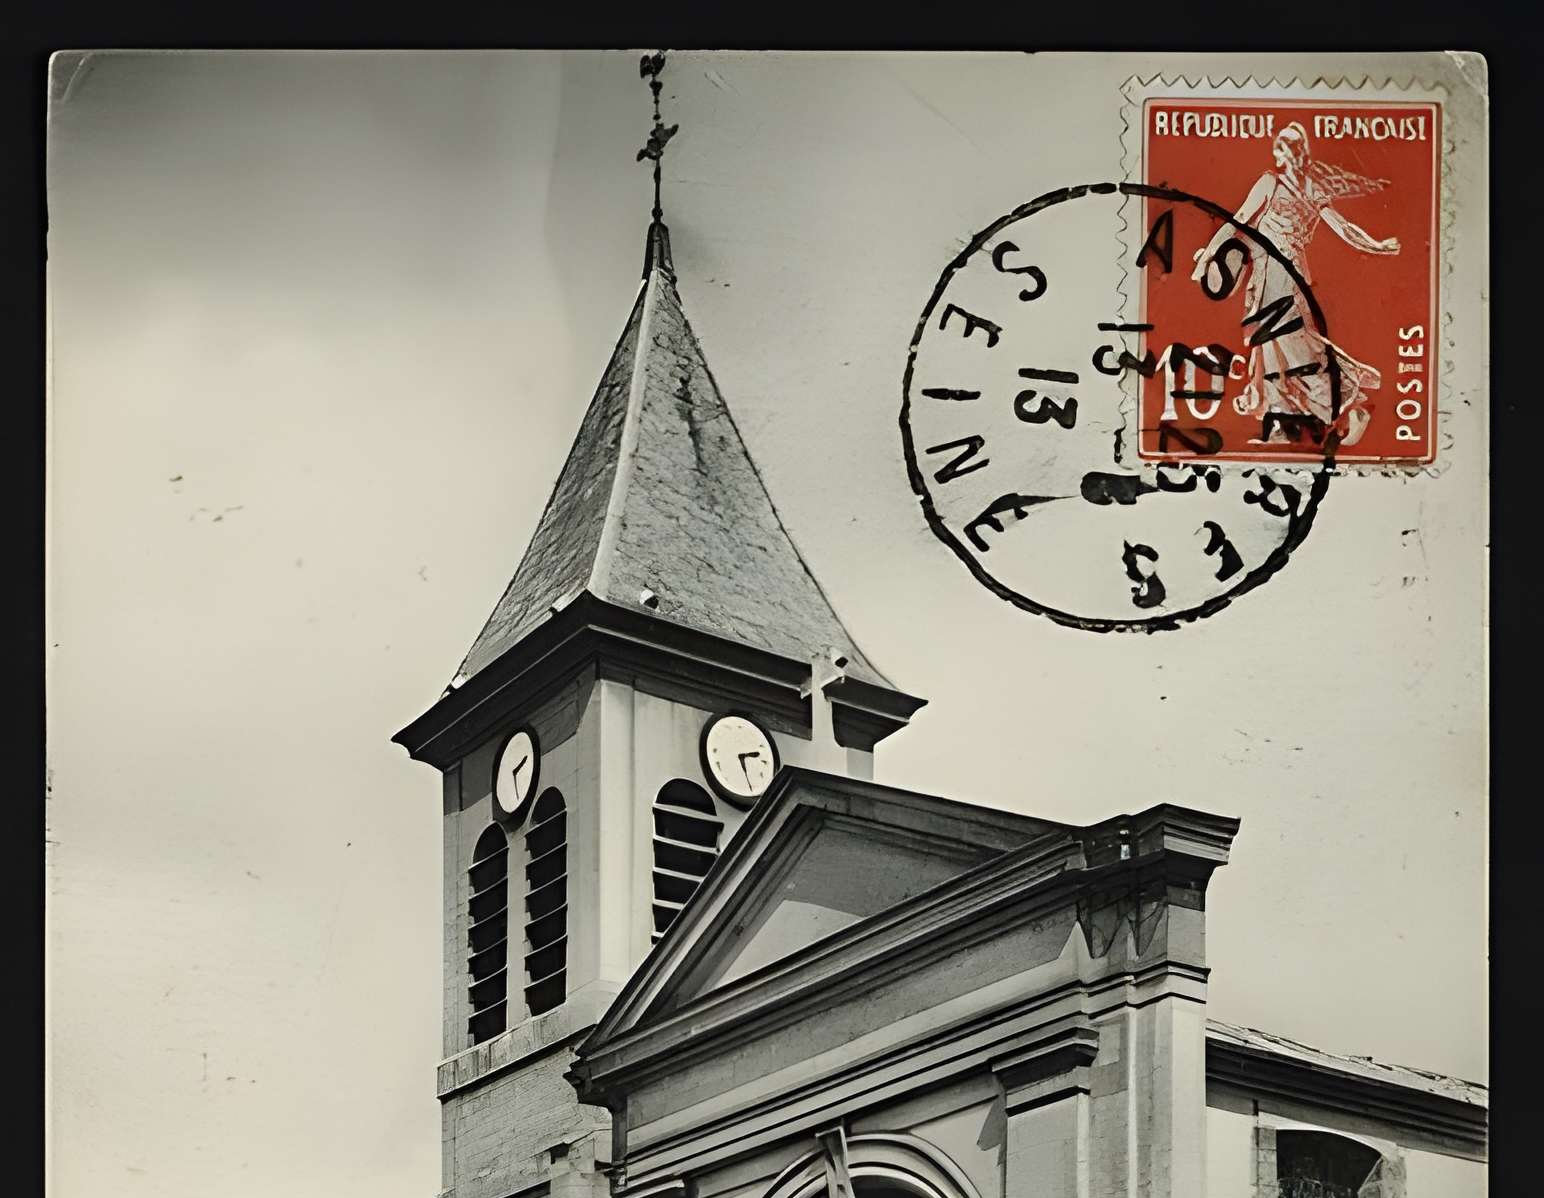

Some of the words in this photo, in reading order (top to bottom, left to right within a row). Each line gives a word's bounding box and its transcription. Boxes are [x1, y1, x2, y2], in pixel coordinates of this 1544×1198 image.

[922, 240, 1047, 552] SEINE
[1013, 367, 1079, 429] 13
[1395, 324, 1424, 441] POSTES
